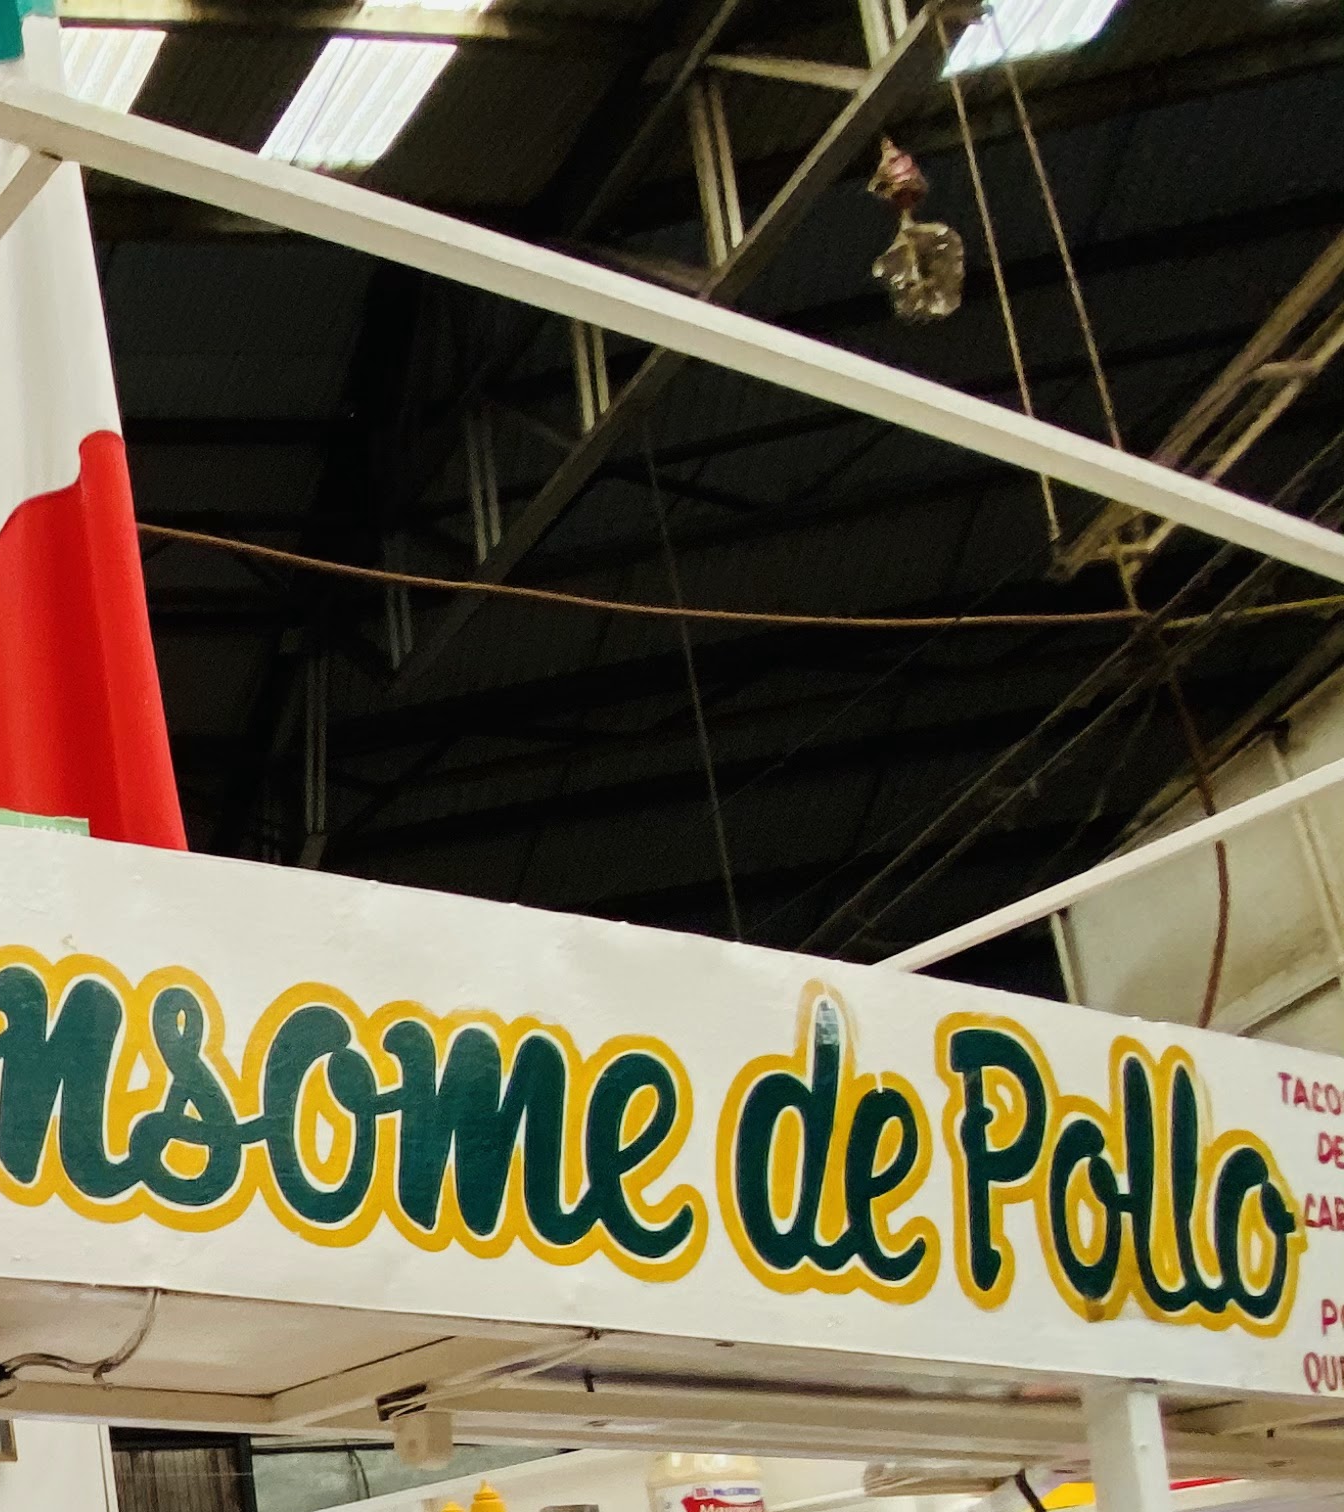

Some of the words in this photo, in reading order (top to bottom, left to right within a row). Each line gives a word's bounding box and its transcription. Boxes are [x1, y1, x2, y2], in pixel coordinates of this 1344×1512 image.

[716, 978, 940, 1306] de
[935, 1012, 1307, 1337] Pollo
[1278, 1072, 1344, 1116] TACO
